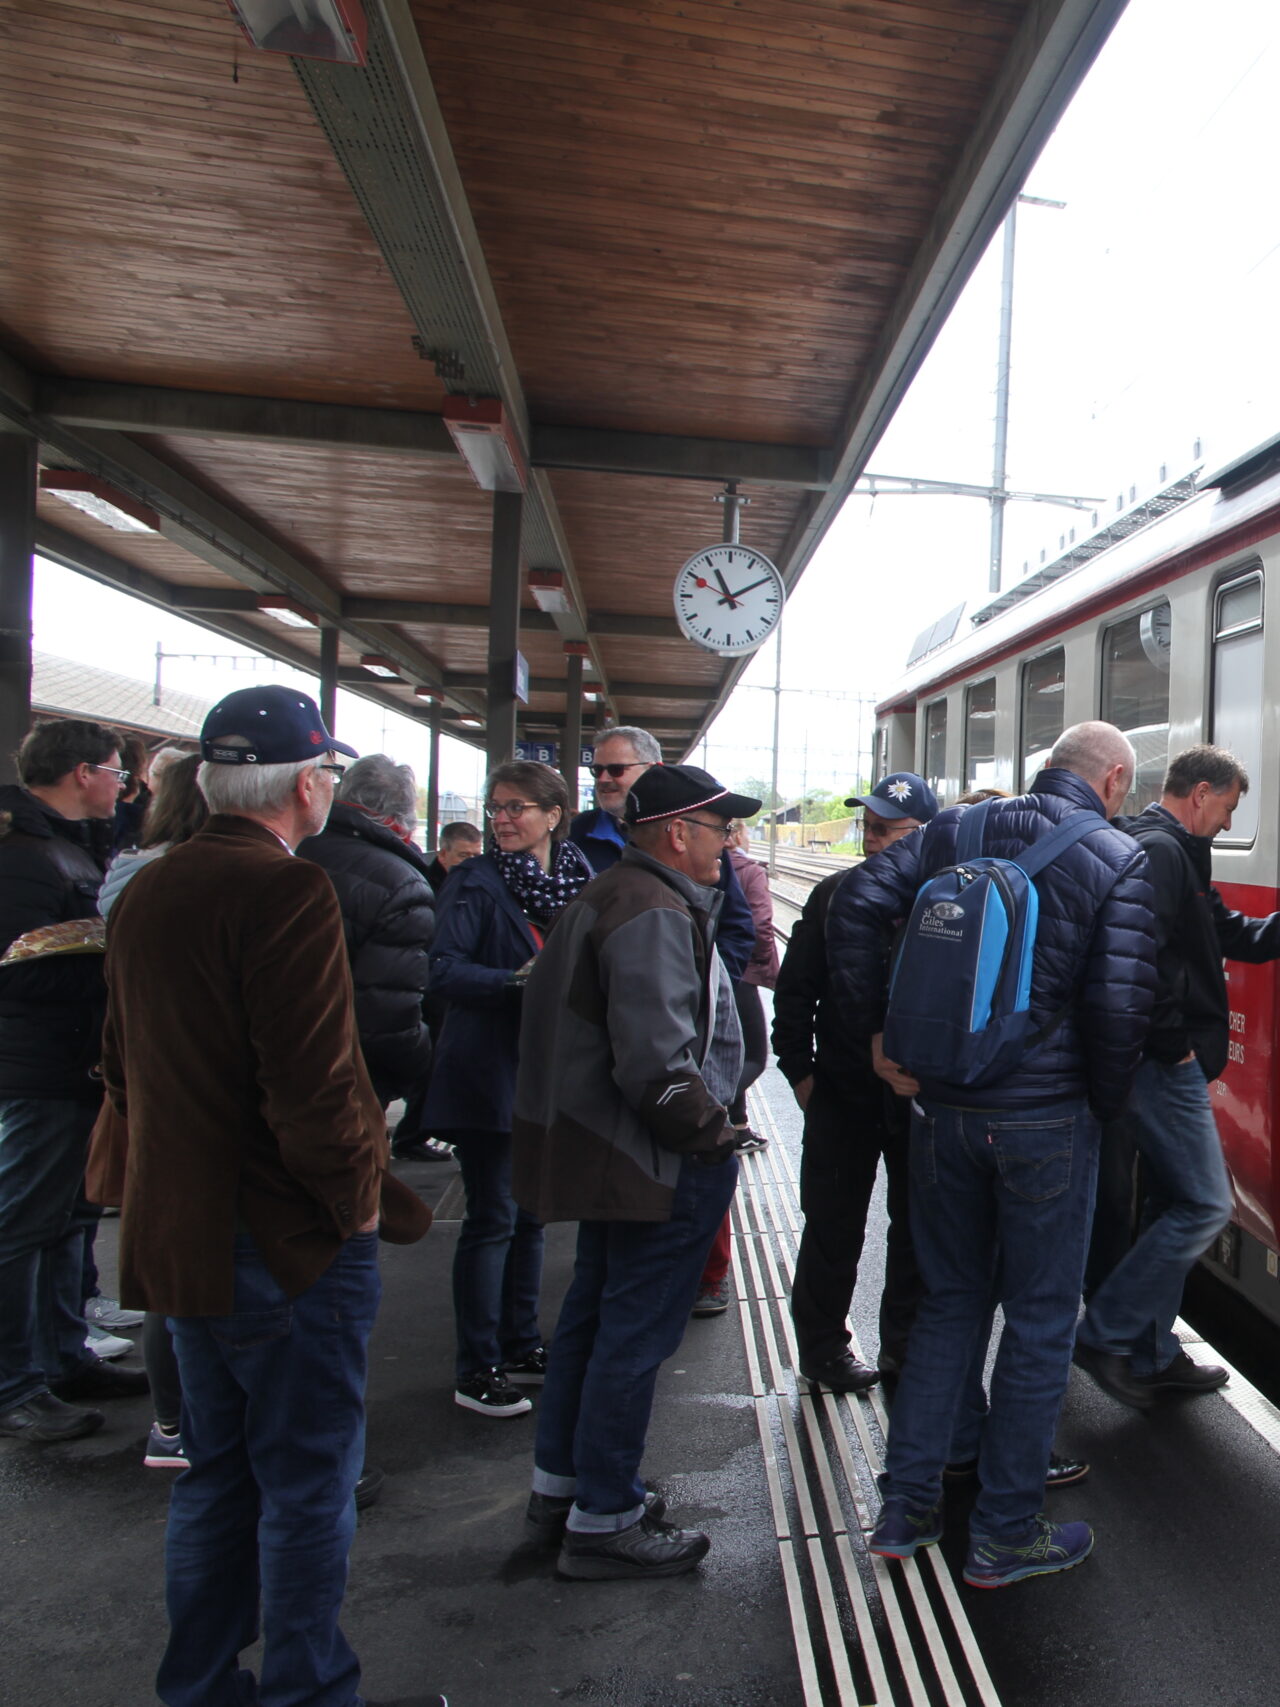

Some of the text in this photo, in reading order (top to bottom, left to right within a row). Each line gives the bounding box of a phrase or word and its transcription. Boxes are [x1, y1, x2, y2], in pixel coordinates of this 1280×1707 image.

[538, 750, 549, 761] B
[582, 751, 593, 763] B
[921, 914, 945, 927] Giles
[919, 923, 963, 937] International
